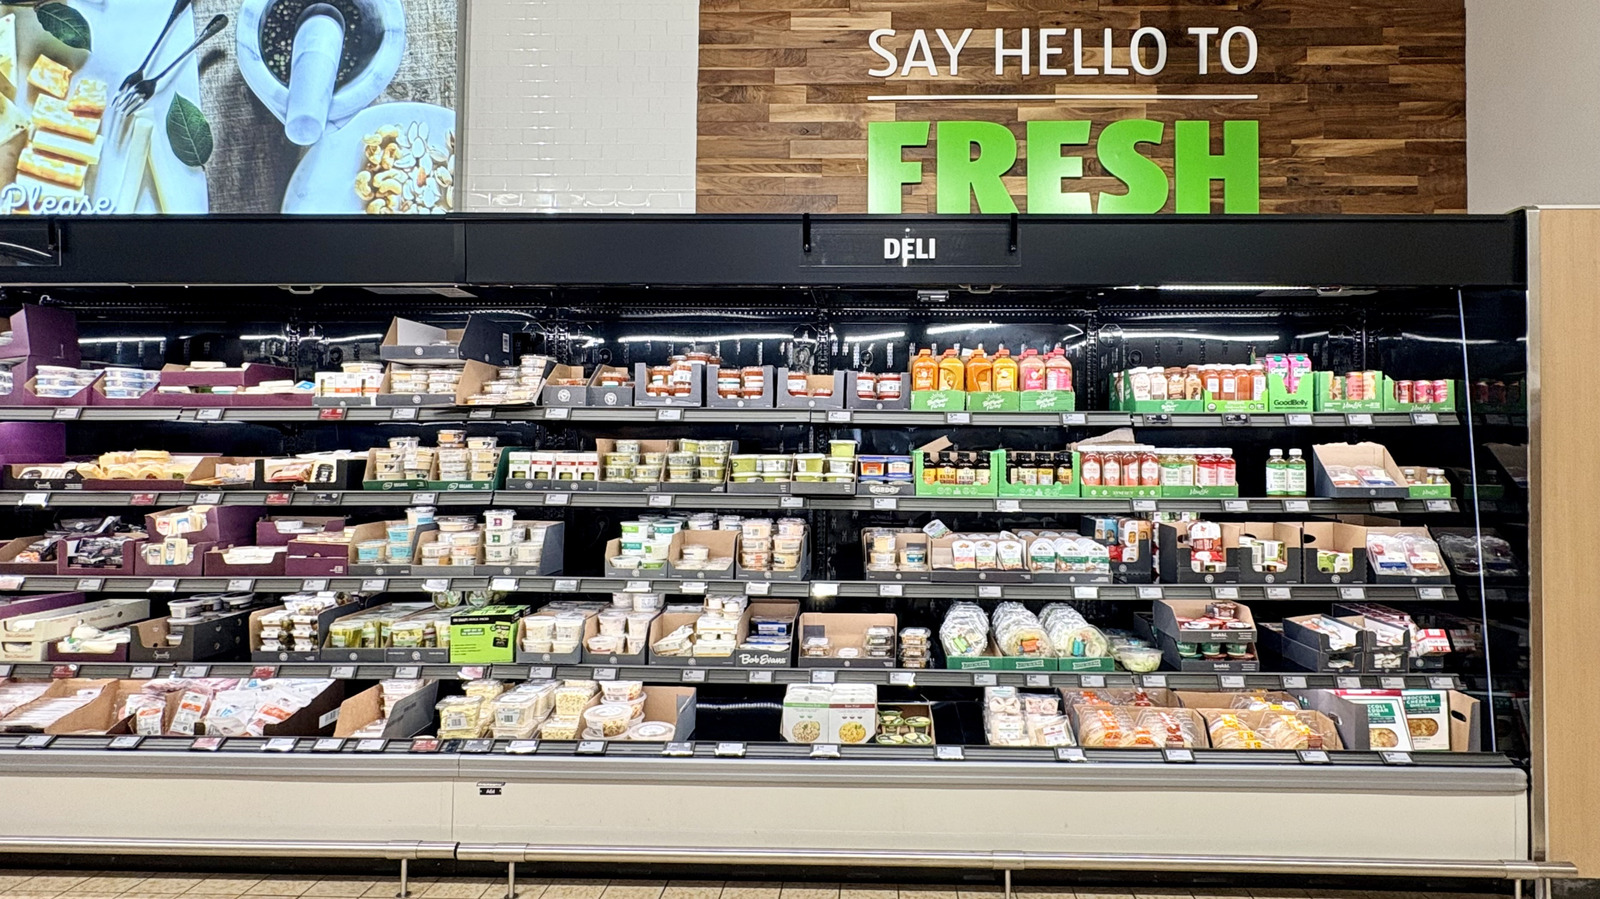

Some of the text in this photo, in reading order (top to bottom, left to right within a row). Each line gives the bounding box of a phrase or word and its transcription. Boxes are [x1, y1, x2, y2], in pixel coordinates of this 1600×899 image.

[868, 26, 1259, 77] SAY HELLO TO
[868, 119, 1260, 214] FRESH
[1, 183, 117, 215] Please
[884, 238, 936, 259] DELI
[1273, 399, 1309, 407] GoodBelly
[739, 653, 786, 665] Bob Evans
